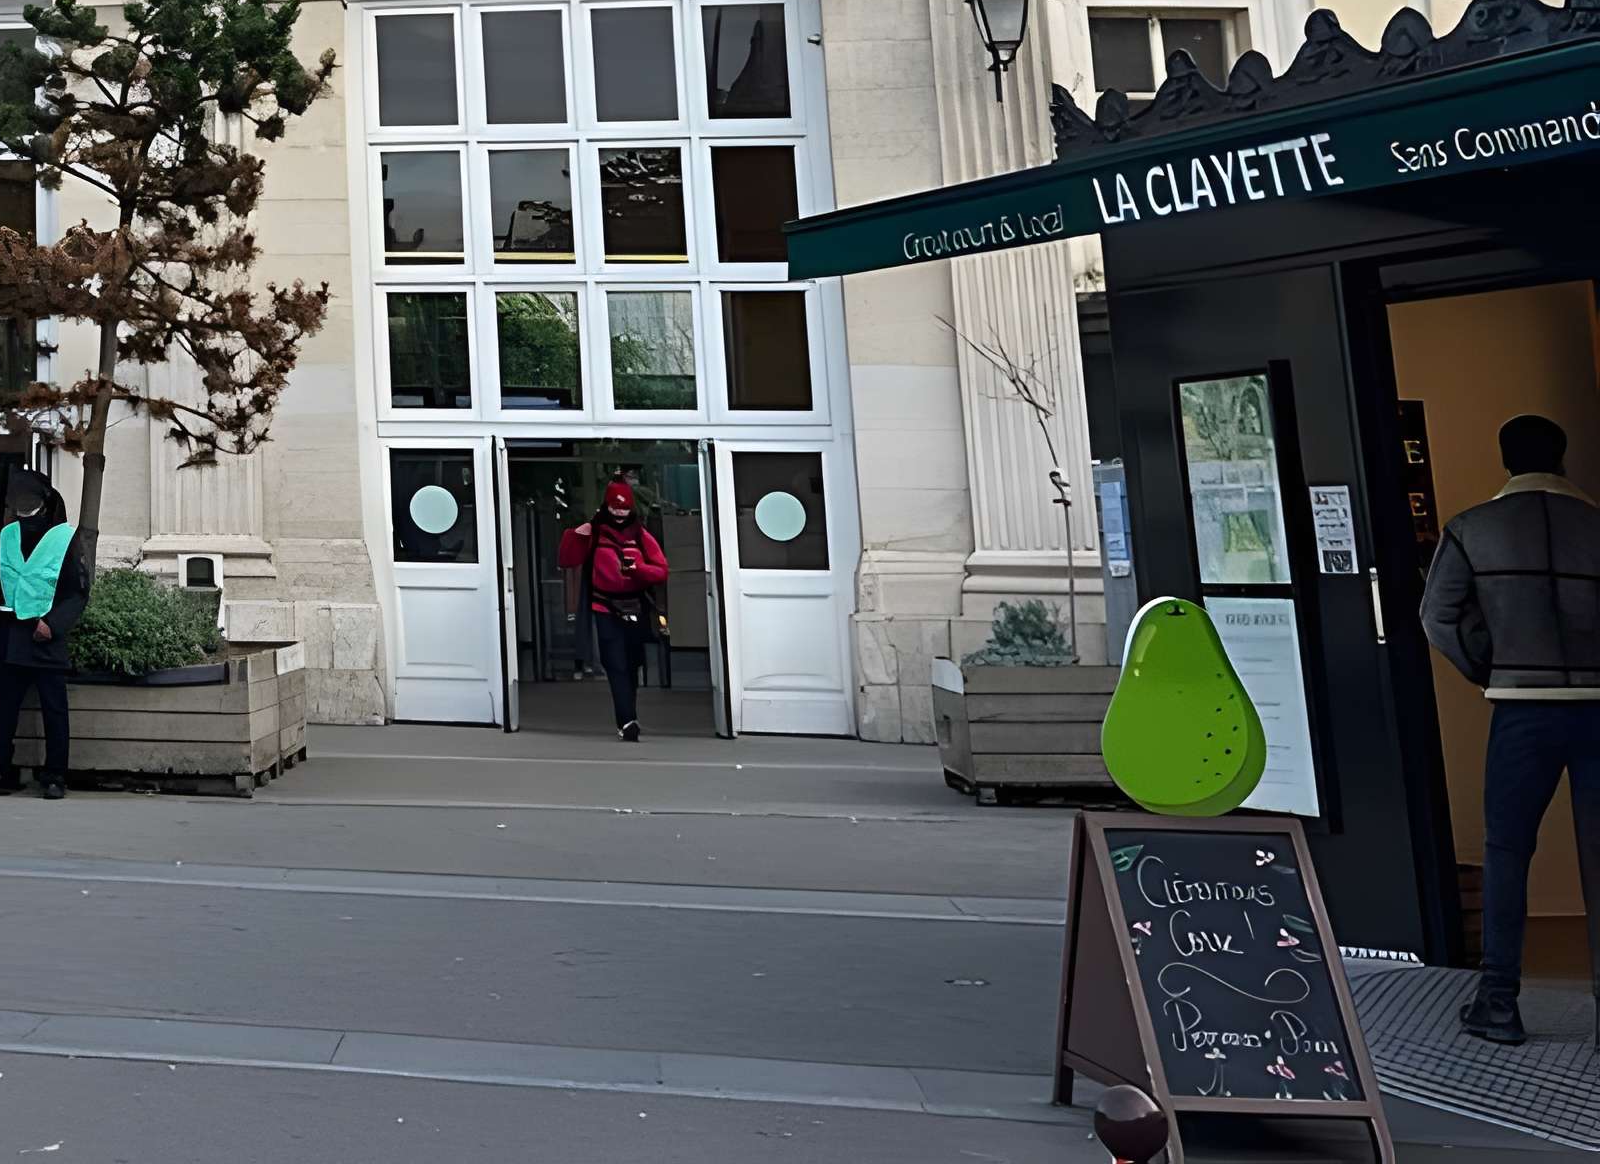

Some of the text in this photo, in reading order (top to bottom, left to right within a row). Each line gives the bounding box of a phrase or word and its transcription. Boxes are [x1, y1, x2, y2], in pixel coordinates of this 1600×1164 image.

[1092, 133, 1345, 224] LA CLAYETTE
[1390, 140, 1448, 173] Sans
